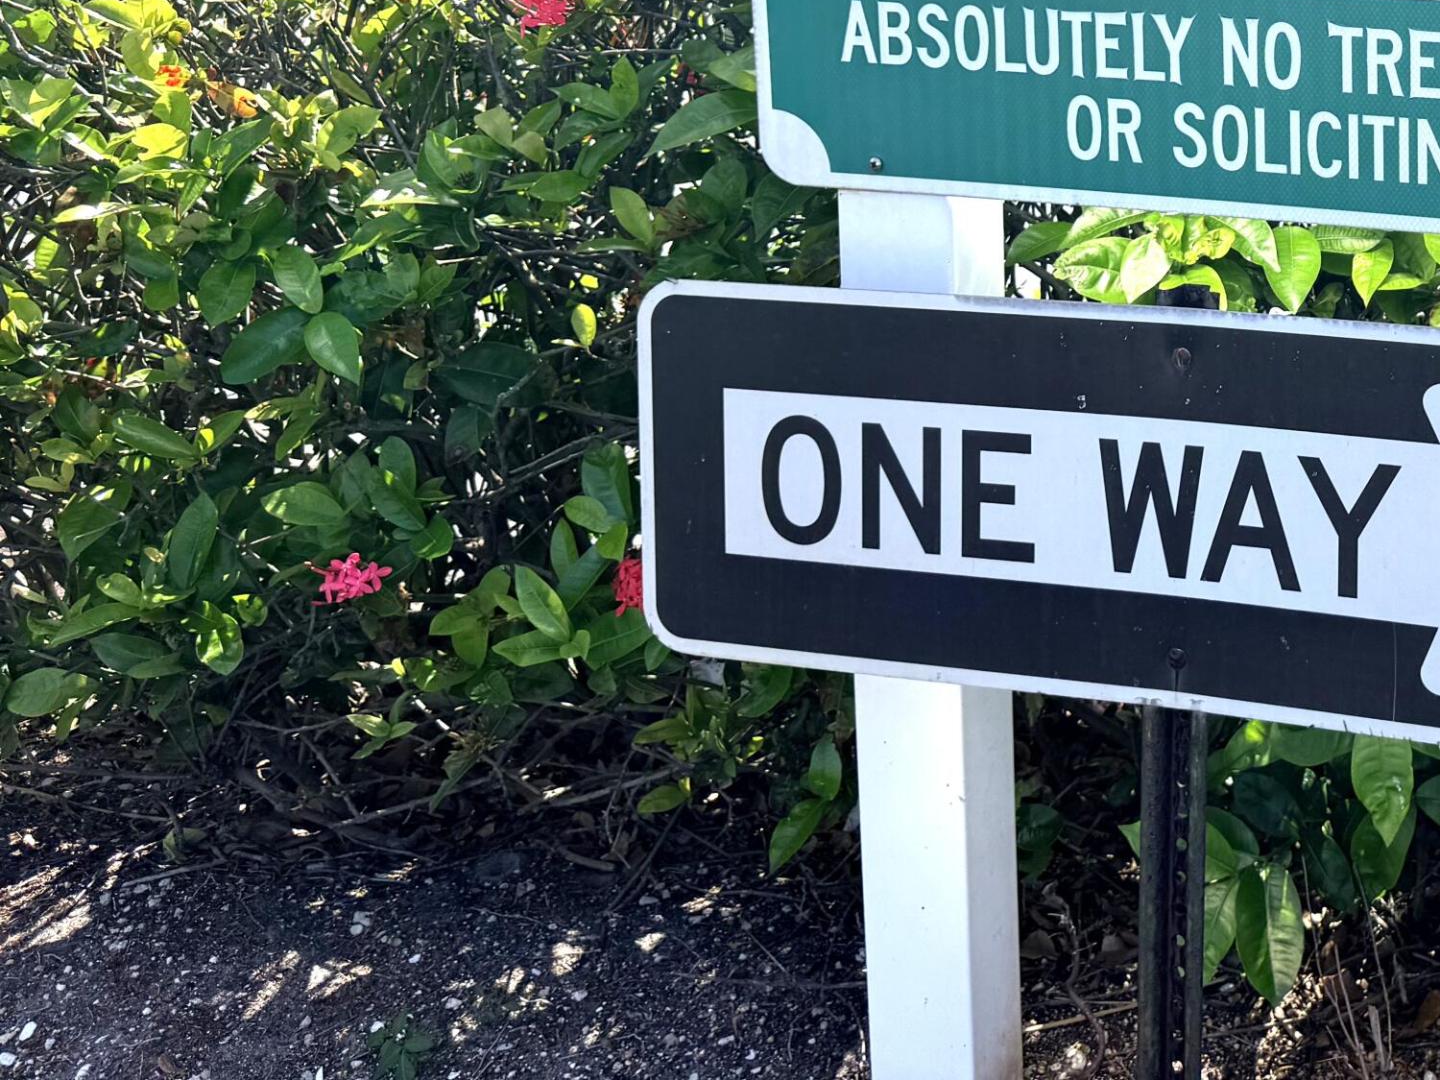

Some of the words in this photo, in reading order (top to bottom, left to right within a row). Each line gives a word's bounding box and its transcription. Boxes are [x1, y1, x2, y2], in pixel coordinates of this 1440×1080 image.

[841, 0, 1195, 85] ABSOLUTELY
[1220, 17, 1301, 90] NO
[1067, 95, 1142, 163] OR
[762, 416, 1034, 563] ONE
[1099, 439, 1401, 598] WAY
